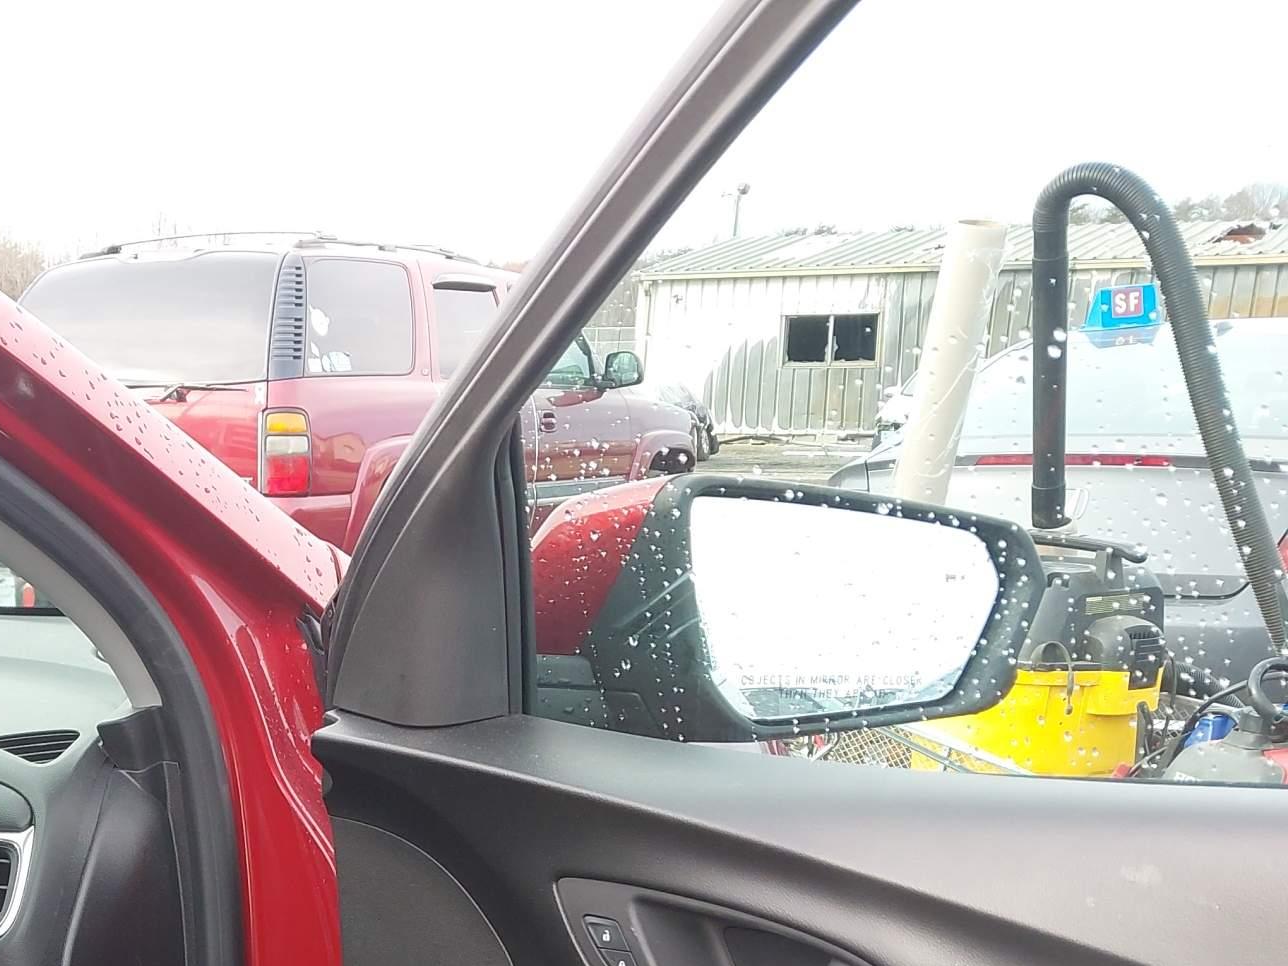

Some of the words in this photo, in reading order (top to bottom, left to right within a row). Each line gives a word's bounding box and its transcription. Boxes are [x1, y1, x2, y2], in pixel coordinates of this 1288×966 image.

[1114, 291, 1140, 314] SF
[740, 674, 791, 686] OBJECTS
[795, 674, 806, 685] IN
[810, 674, 850, 686] MIRROR
[856, 674, 876, 685] ARE
[882, 674, 922, 686] CLOSER
